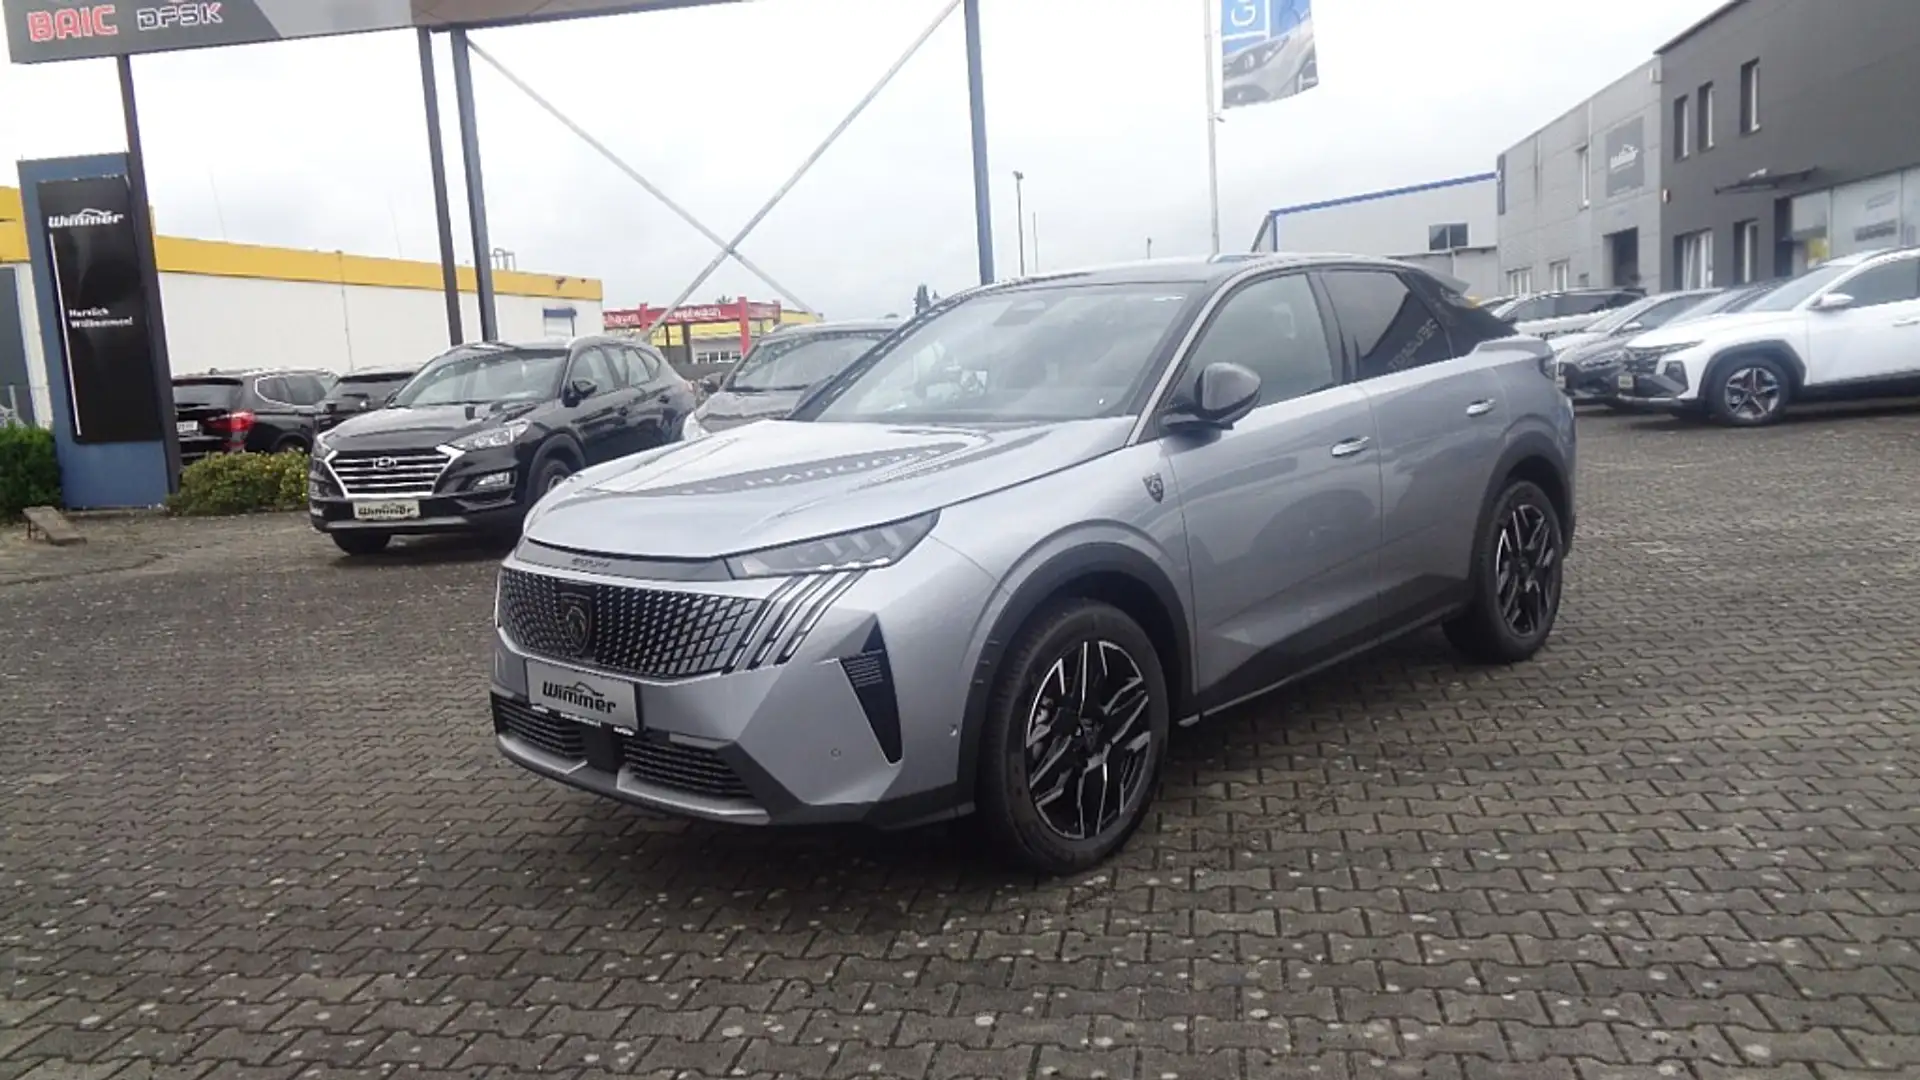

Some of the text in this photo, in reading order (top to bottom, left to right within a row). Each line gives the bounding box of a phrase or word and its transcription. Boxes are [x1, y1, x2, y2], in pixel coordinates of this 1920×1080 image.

[27, 3, 223, 42] BAIC DFSK
[542, 681, 616, 713] Wimmer
